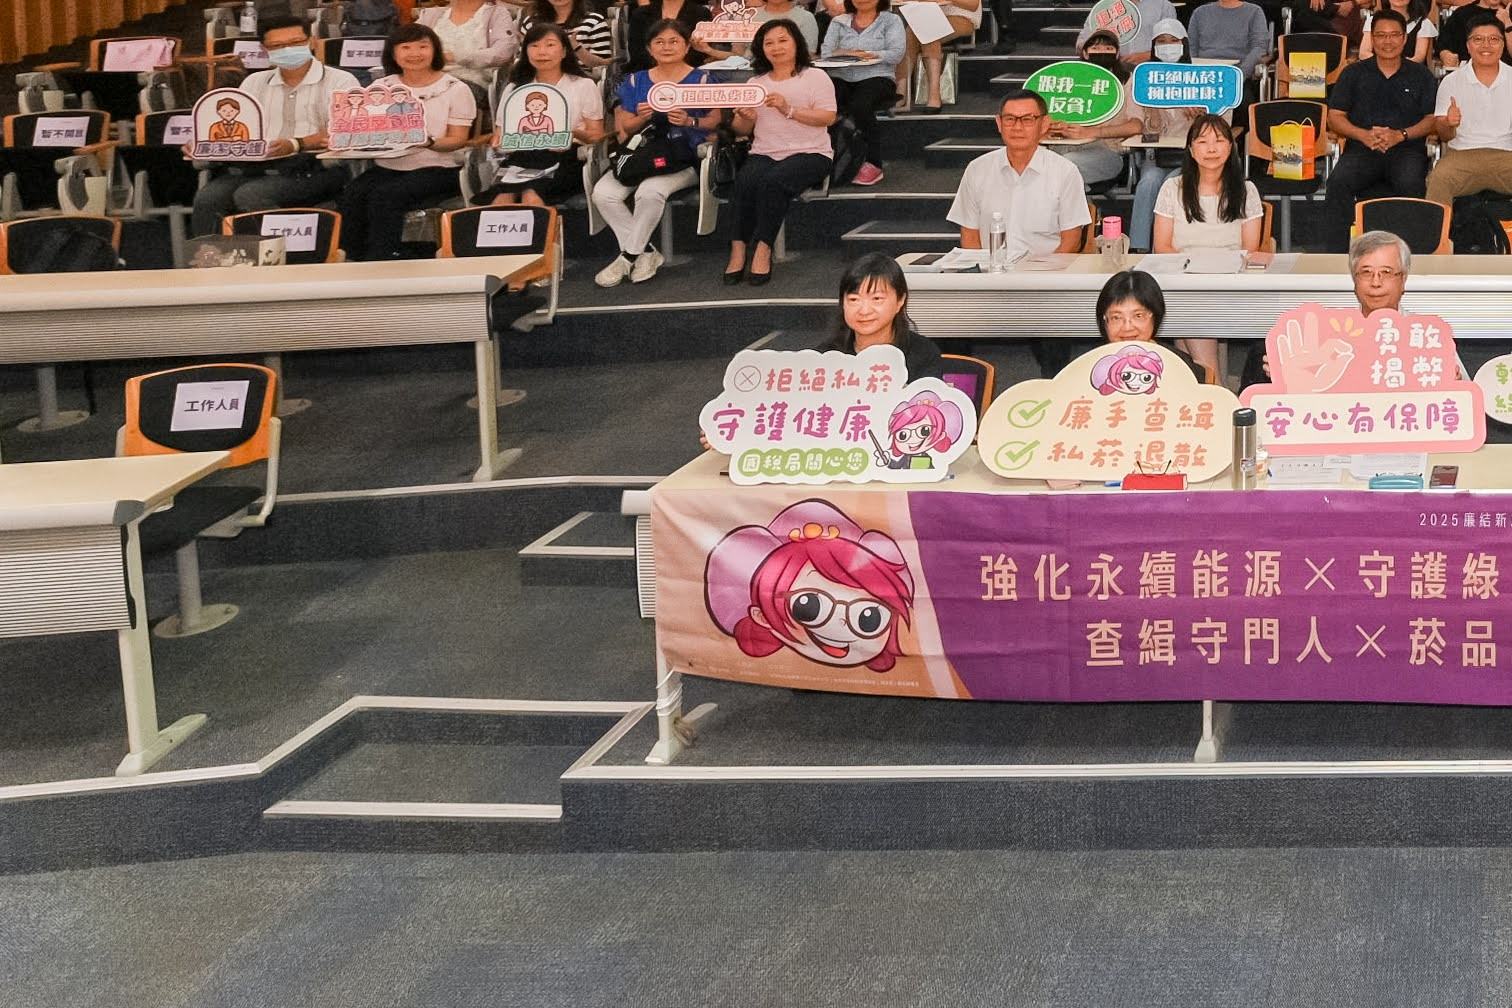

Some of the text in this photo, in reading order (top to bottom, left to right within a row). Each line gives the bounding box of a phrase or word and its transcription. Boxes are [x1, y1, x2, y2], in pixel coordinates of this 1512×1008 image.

[1037, 74, 1110, 96] 跟我一起
[1147, 70, 1224, 85] 拒絕私菸!
[682, 89, 758, 103] 拒絕私劣菸
[1147, 86, 1224, 101] 擁抱健康!
[1049, 96, 1092, 115] 反貪!
[270, 224, 314, 238] 工作人員
[485, 222, 529, 234] 工作人員
[1375, 317, 1443, 356] 勇敢
[764, 363, 893, 394] 拒絕私菸
[1370, 354, 1444, 388] 揭弊
[183, 397, 240, 413] 工作人員
[1058, 395, 1215, 432] 廉手查緝
[712, 399, 872, 442] 守護健康
[1264, 398, 1460, 439] 安心有保障
[742, 452, 866, 473] 國稅局關心您
[1046, 438, 1208, 468] 私菸退散
